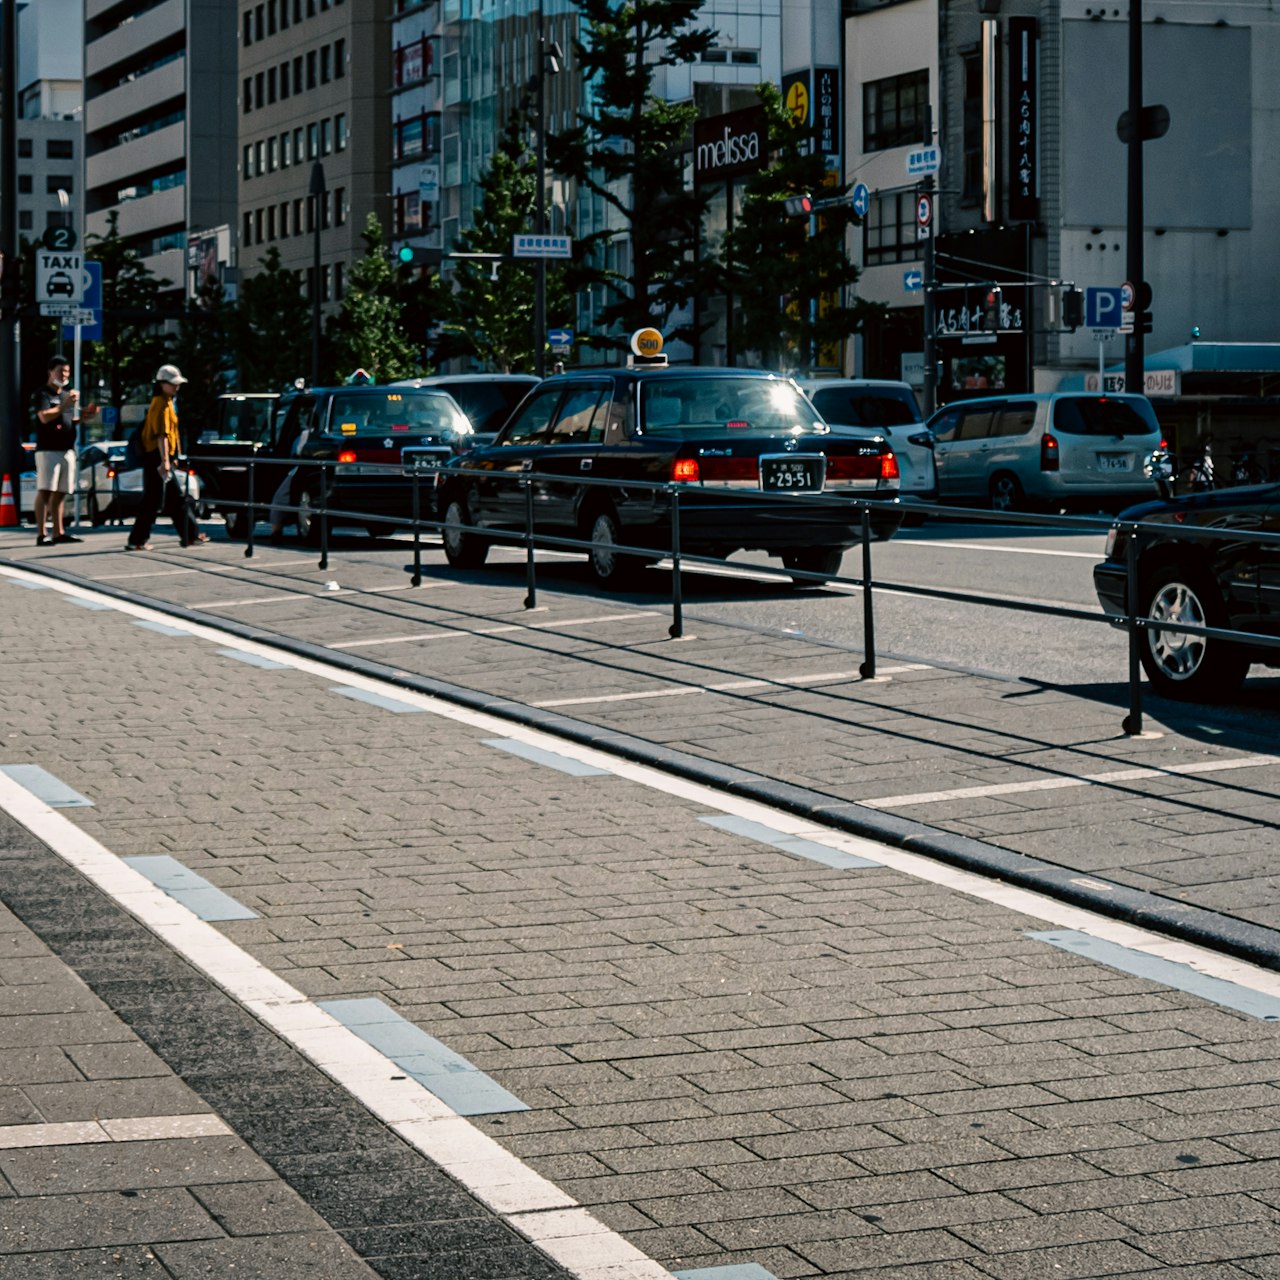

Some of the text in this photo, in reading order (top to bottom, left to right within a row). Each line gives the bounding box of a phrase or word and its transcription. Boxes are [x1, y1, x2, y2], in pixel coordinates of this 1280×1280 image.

[697, 125, 760, 172] melissa
[55, 229, 69, 247] 2
[42, 256, 79, 269] TAXI
[1096, 291, 1115, 323] P
[937, 303, 1022, 331] A5肉十番店
[640, 339, 658, 349] 500
[777, 472, 812, 487] 29-51
